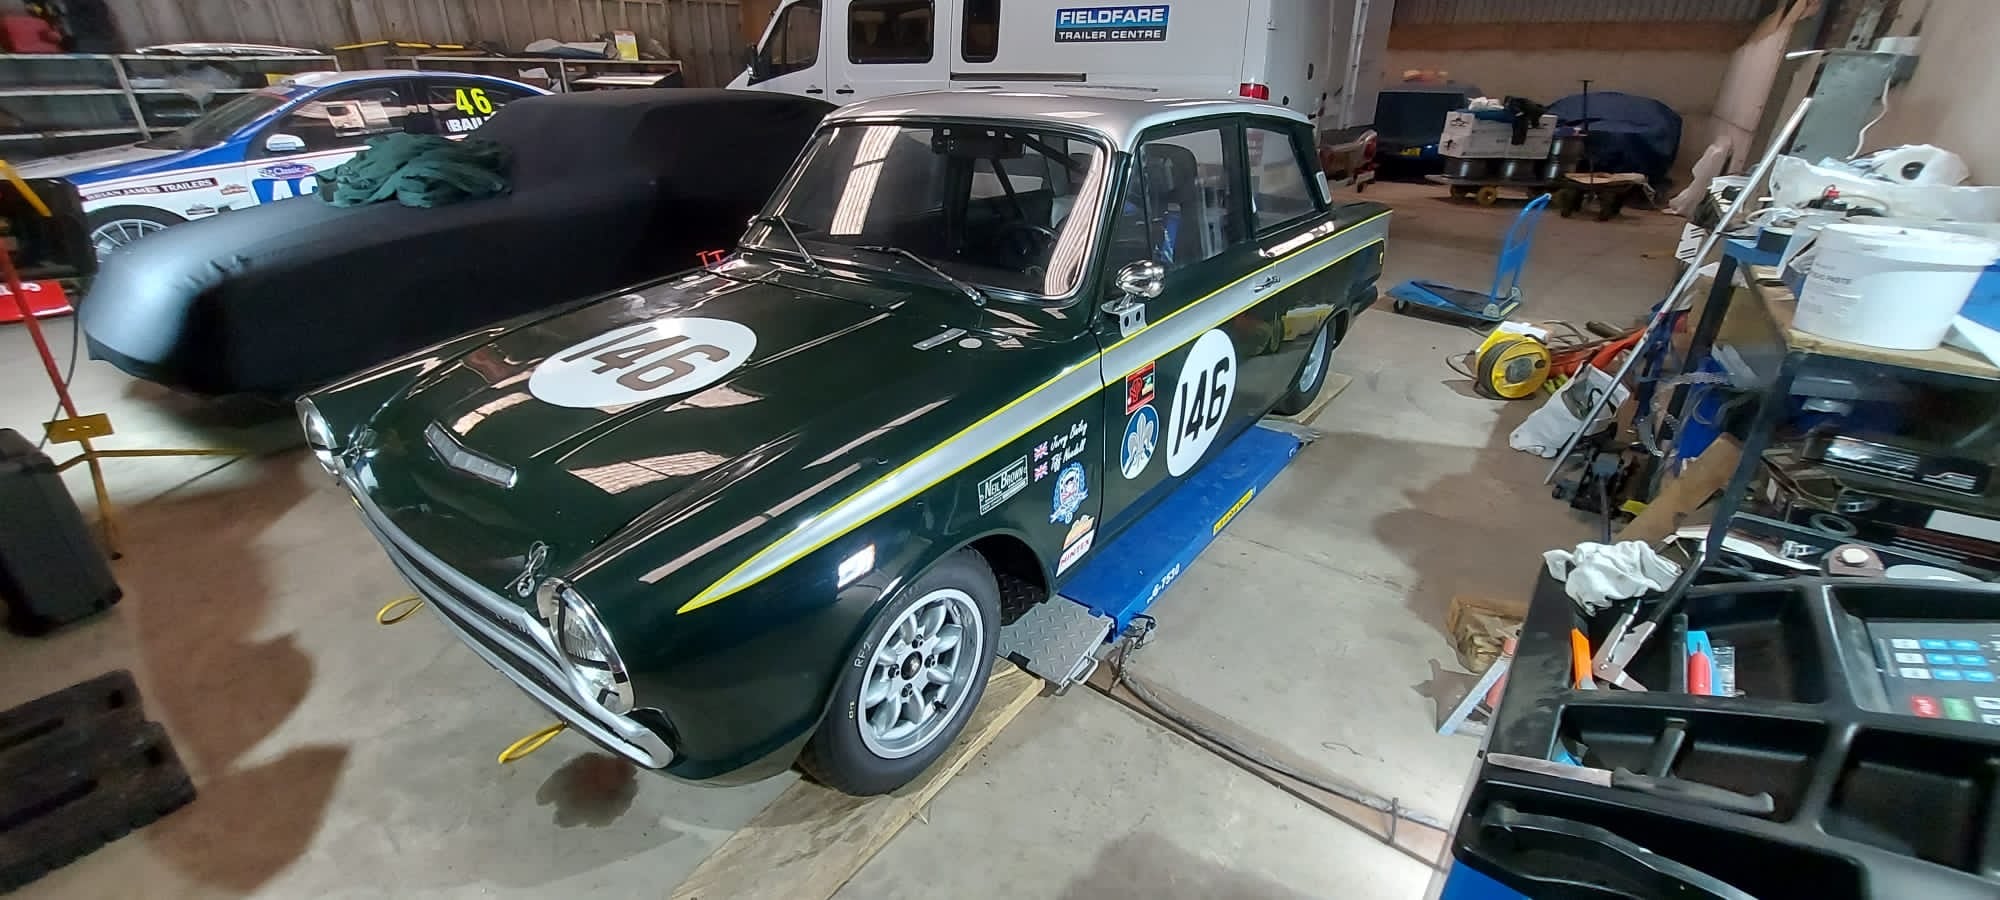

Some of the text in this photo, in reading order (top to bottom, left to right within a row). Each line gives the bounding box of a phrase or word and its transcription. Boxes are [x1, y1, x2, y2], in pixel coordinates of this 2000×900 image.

[1060, 8, 1165, 25] FIELDFARE
[1059, 29, 1161, 39] TRAILER CENTRE
[455, 88, 492, 115] 46
[160, 178, 214, 193] TRAILERS
[560, 326, 731, 392] 146
[1172, 356, 1231, 457] 146
[1000, 464, 1024, 491] BROWN
